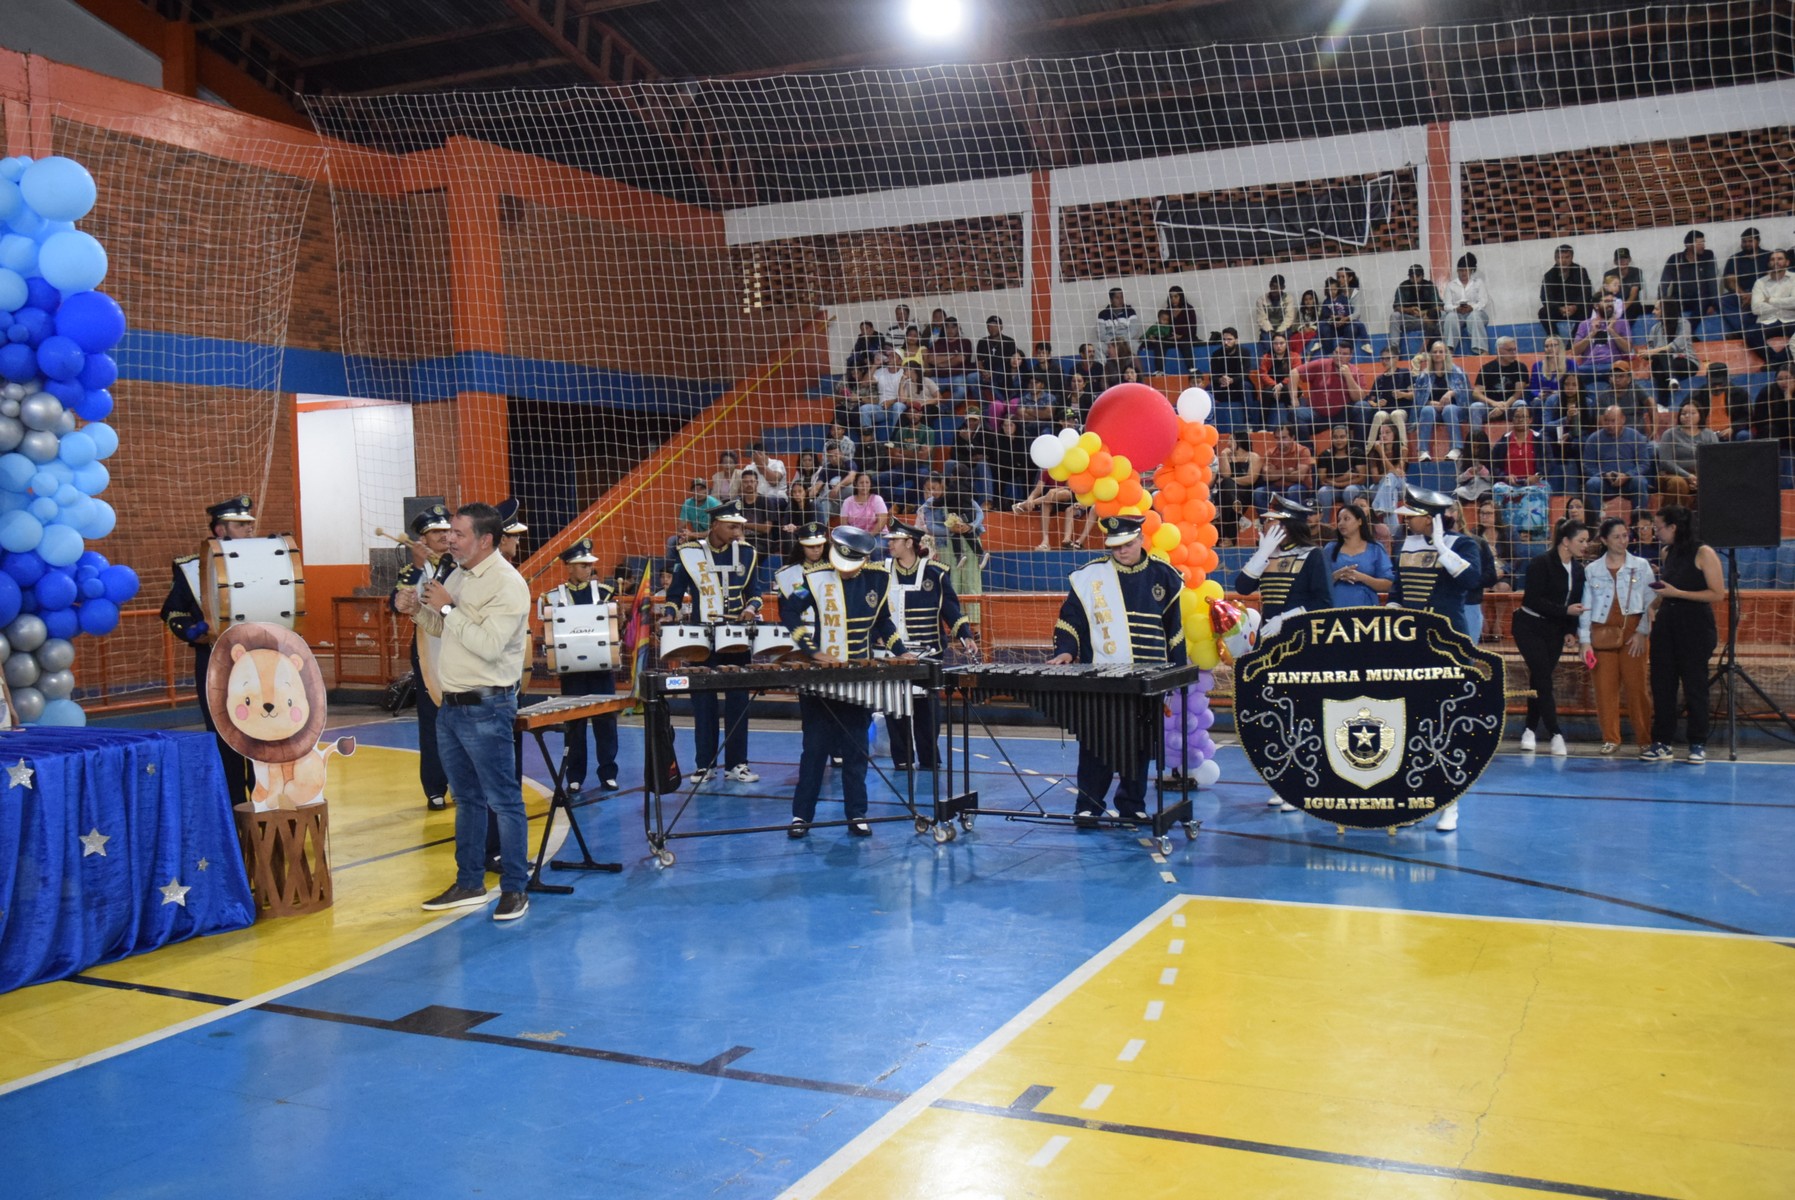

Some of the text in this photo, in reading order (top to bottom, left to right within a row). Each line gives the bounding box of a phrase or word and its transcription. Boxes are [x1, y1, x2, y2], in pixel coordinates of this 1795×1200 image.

[824, 584, 841, 657] FAMIG
[1091, 580, 1117, 654] FAMIG
[1310, 616, 1417, 644] FAMIG
[1267, 667, 1465, 684] FANFARRA MUNICIPAL
[1304, 797, 1395, 809] IGUATEMI
[1408, 797, 1435, 809] MS
